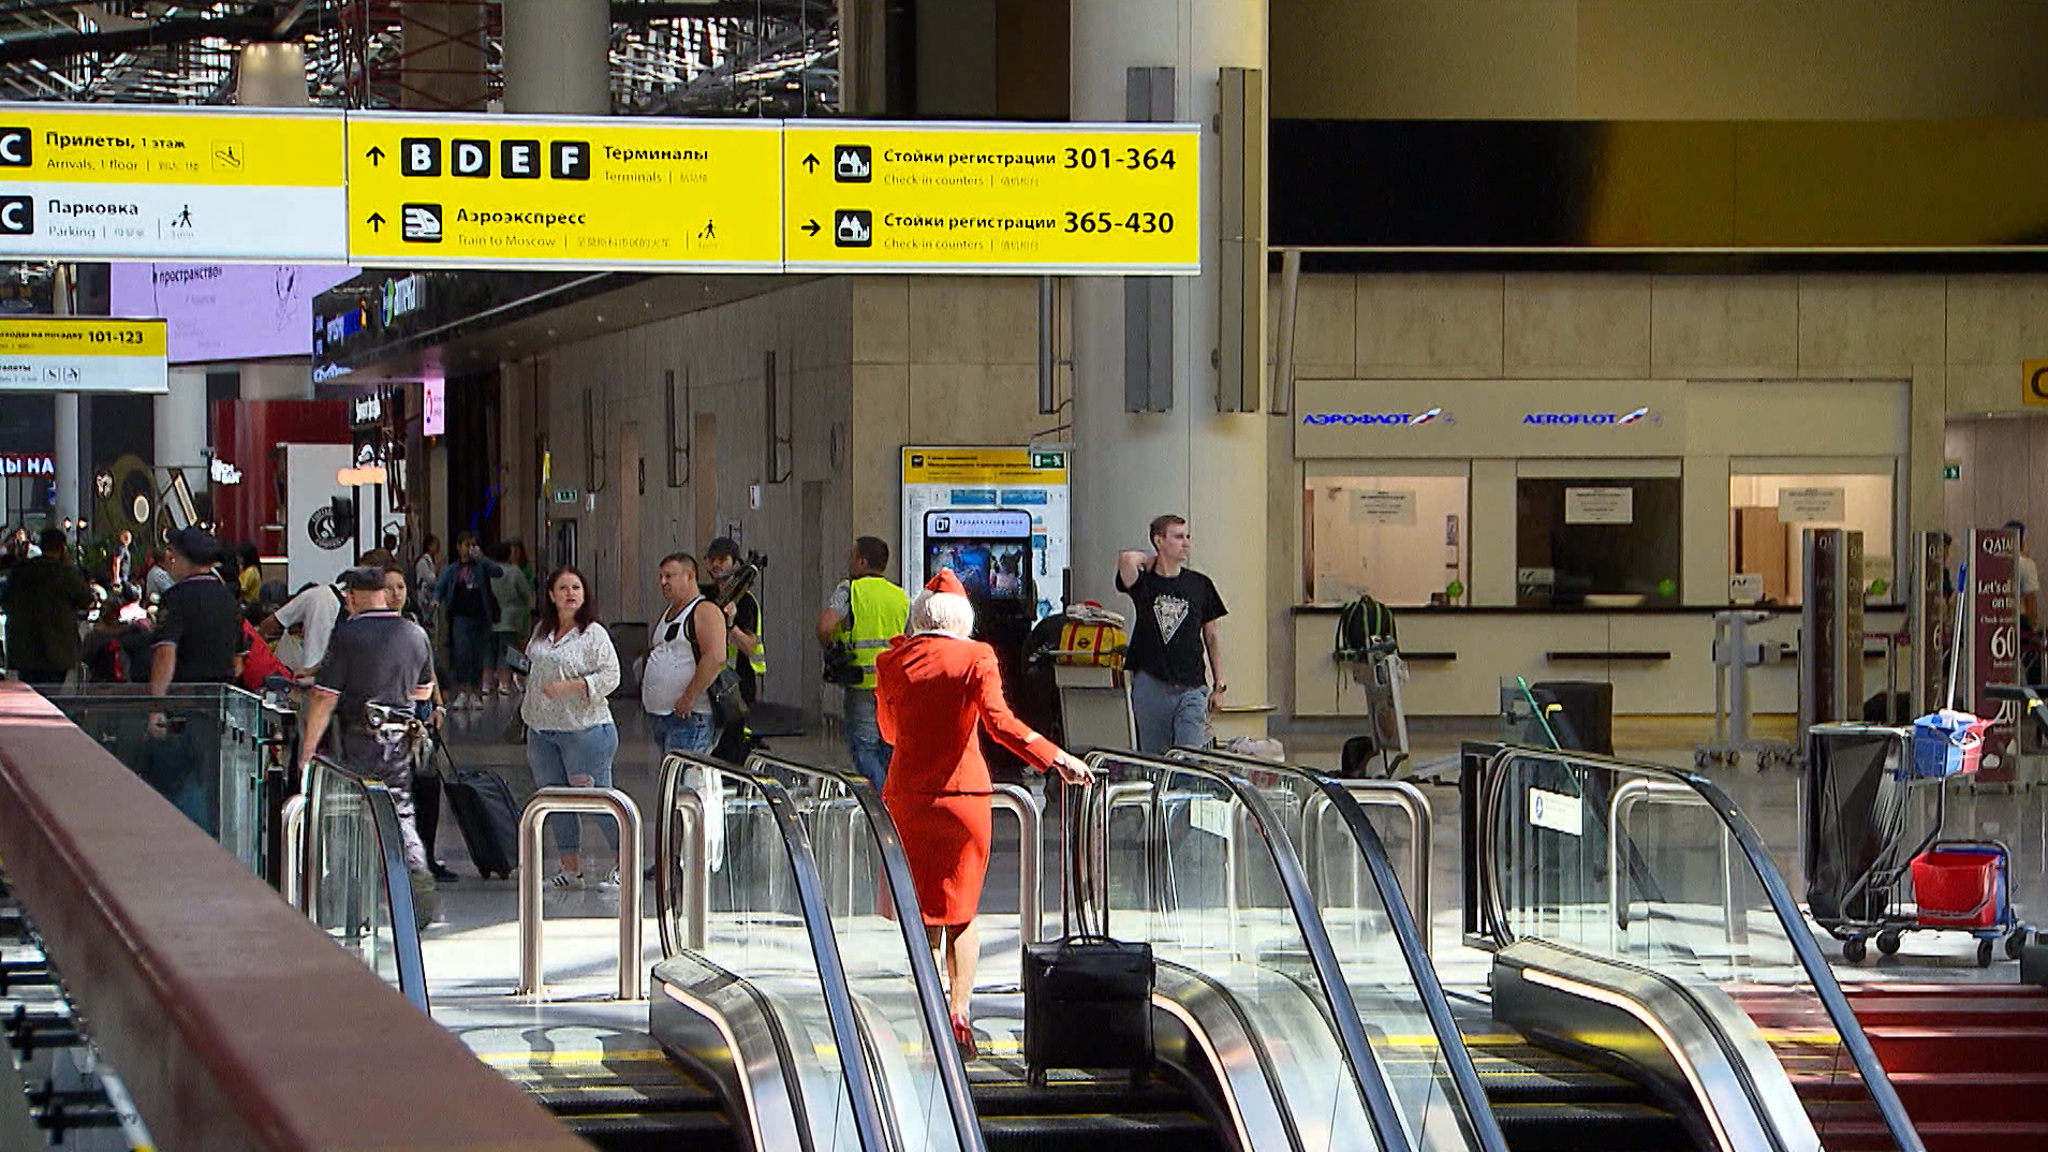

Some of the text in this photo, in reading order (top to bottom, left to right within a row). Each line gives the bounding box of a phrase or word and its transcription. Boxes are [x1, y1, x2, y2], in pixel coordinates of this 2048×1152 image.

[0, 133, 22, 162] C
[46, 131, 186, 150] Прилеты, 1 этаж
[411, 143, 579, 175] B D E F
[603, 146, 708, 163] Терминалы
[884, 147, 1176, 170] Стойки регистрации 301-364
[605, 170, 662, 182] Terminals
[935, 175, 984, 186] counters
[1, 201, 24, 230] C
[49, 199, 139, 217] Парковка
[457, 208, 587, 228] Аэроэкспресс
[884, 211, 1174, 233] Стойки регистрации 365-430
[50, 225, 96, 239] Parking
[458, 234, 556, 247] Train to Moscow
[935, 239, 984, 250] counters
[88, 331, 144, 344] 101-123
[1303, 413, 1413, 425] АЭРОФЛОТ
[1523, 413, 1618, 425] AEROFLOT
[28, 457, 55, 474] НА
[1990, 626, 2016, 659] 60
